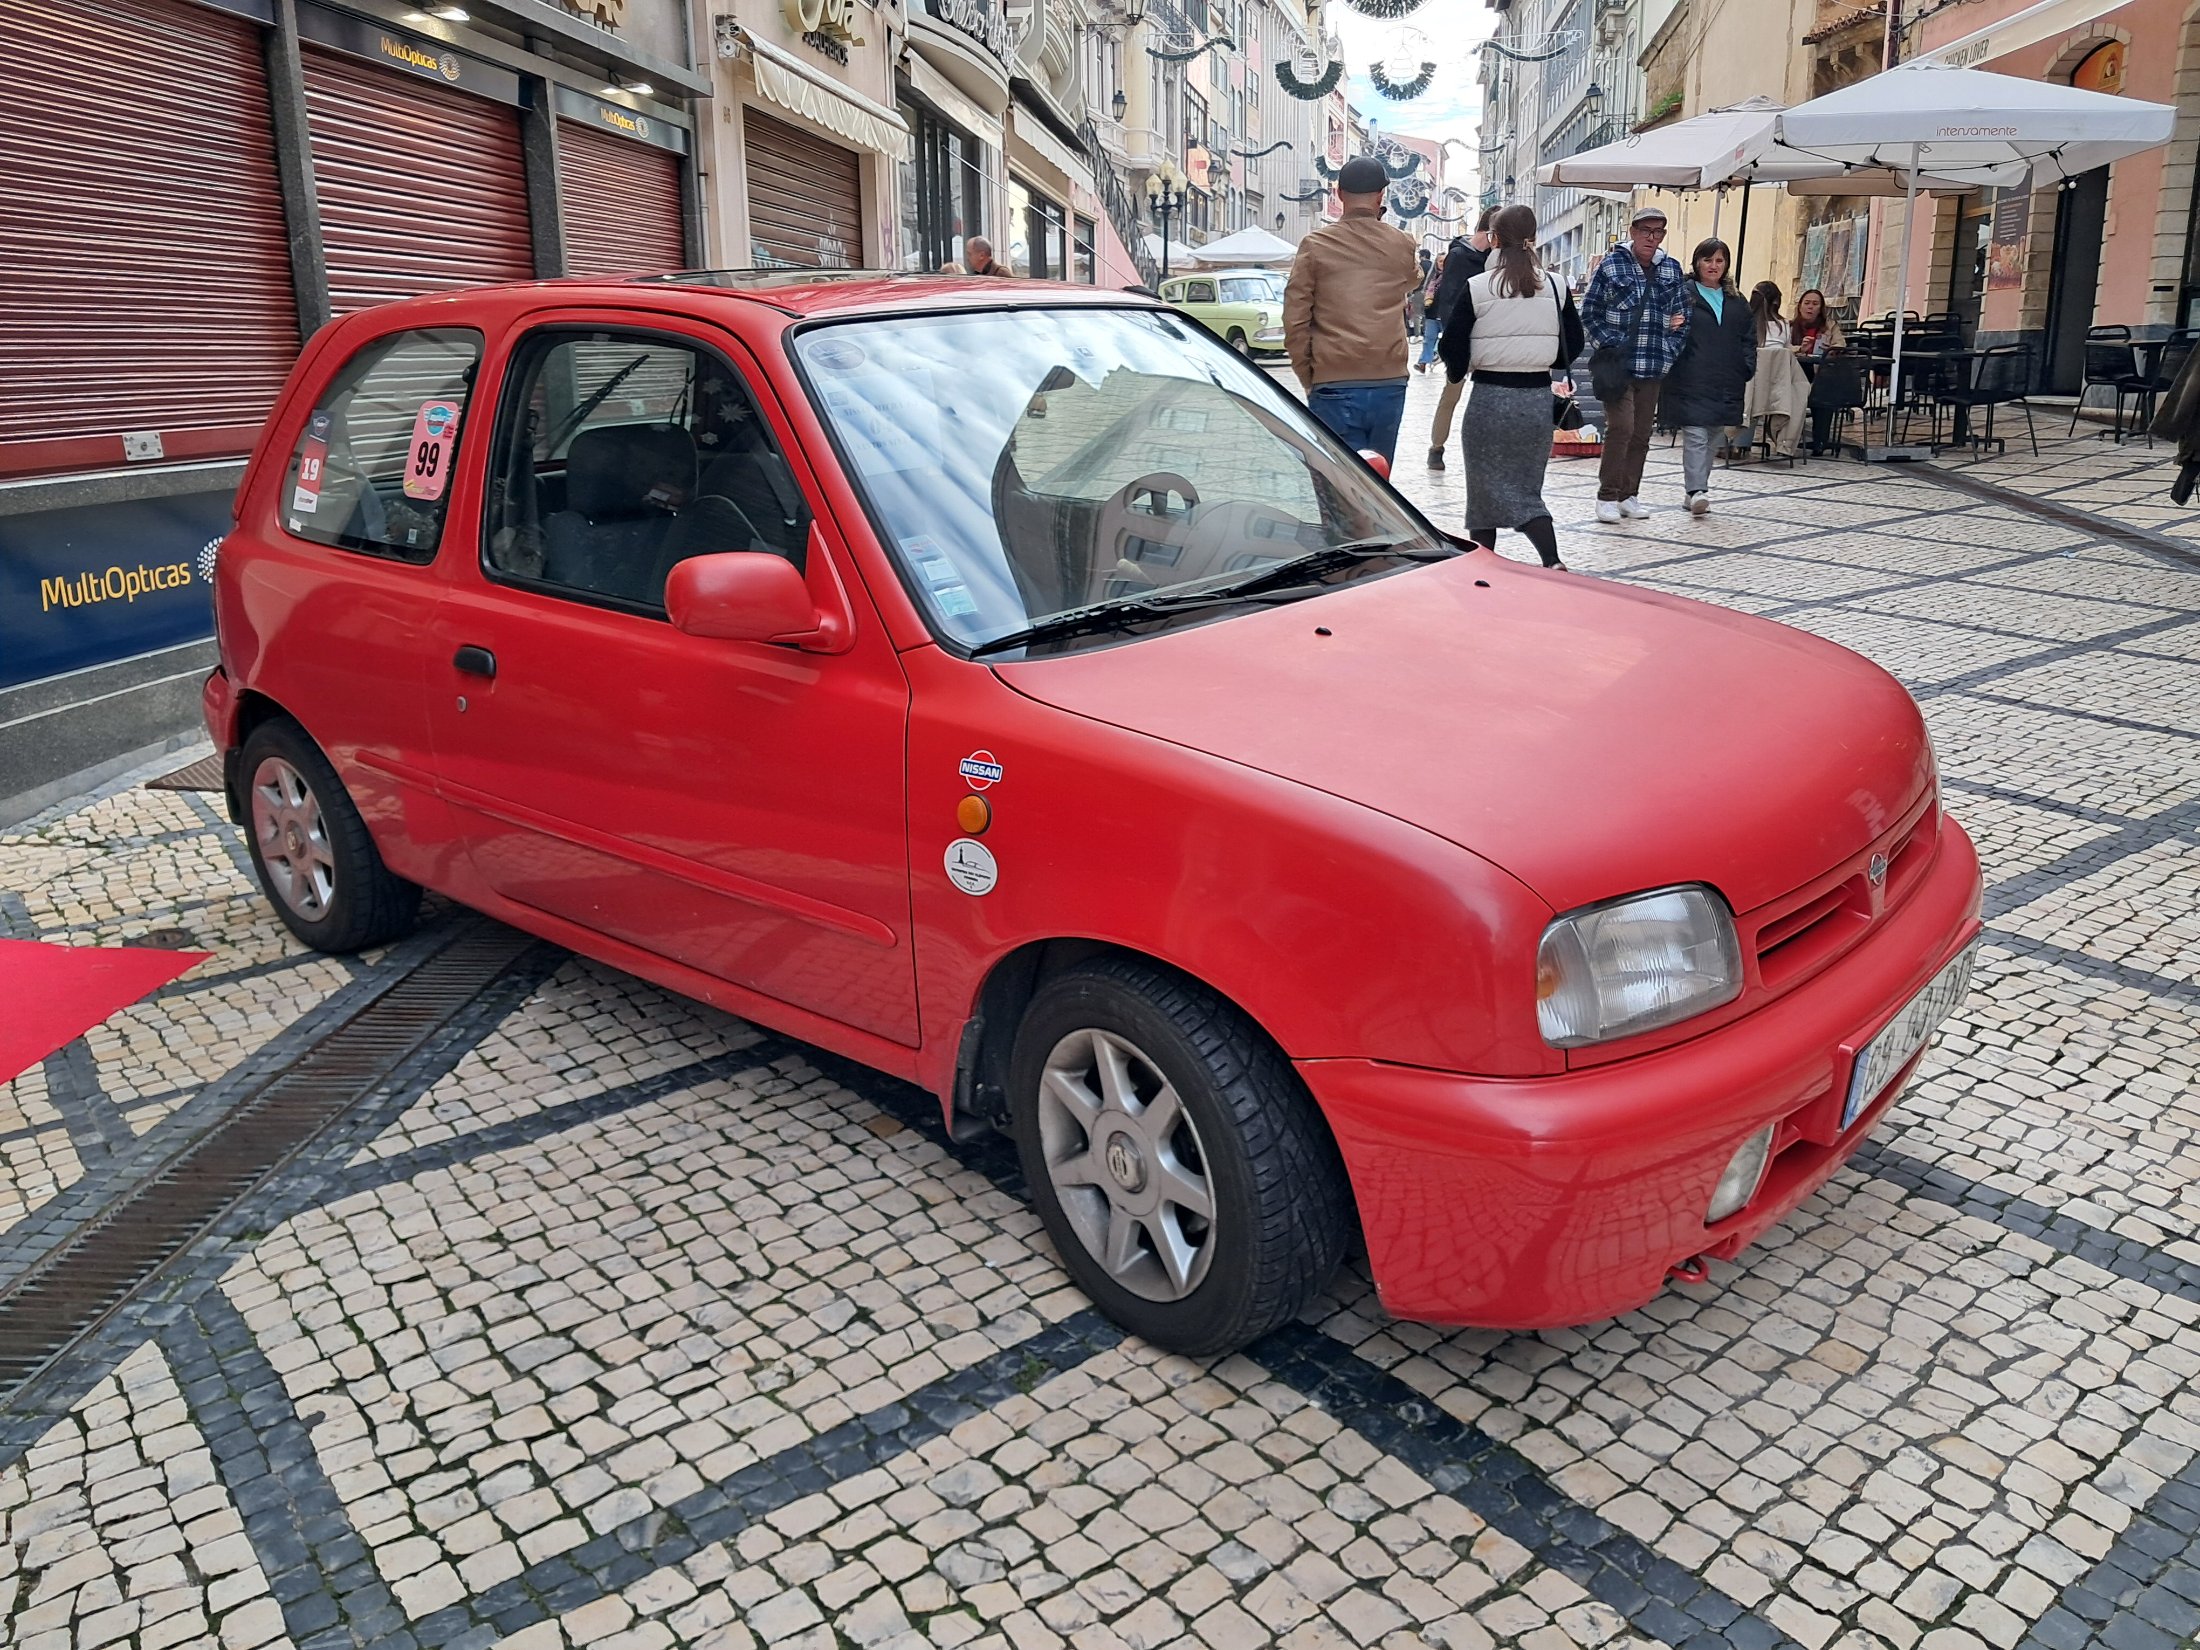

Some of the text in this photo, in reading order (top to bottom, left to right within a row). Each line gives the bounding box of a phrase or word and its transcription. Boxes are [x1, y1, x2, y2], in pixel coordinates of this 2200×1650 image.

[381, 36, 438, 70] MultiOpticas
[1969, 38, 1990, 63] LOVER
[1936, 125, 2018, 137] intensamente
[301, 457, 320, 481] 19
[415, 441, 440, 478] 99
[41, 562, 191, 612] MultiOpticas
[961, 761, 1000, 779] NISSAN
